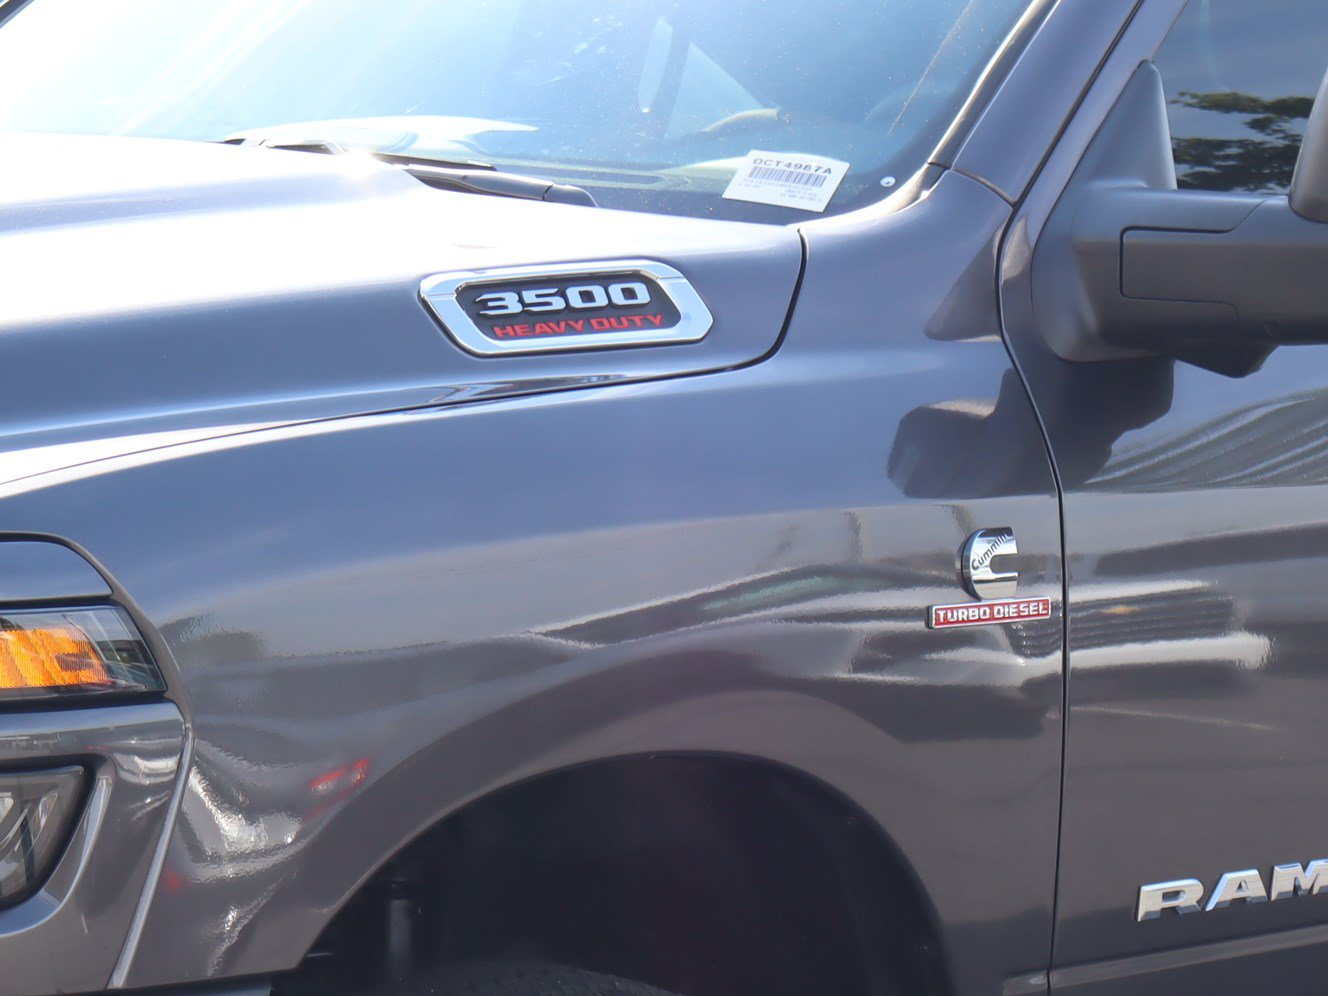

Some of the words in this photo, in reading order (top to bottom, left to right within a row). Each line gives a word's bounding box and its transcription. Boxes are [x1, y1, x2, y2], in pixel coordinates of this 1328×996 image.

[475, 281, 651, 316] 3500
[492, 318, 586, 338] HEAVY
[589, 313, 664, 331] DUTY
[936, 606, 991, 623] TURBO
[993, 602, 1049, 619] DIESEL
[1137, 858, 1328, 922] RAM
